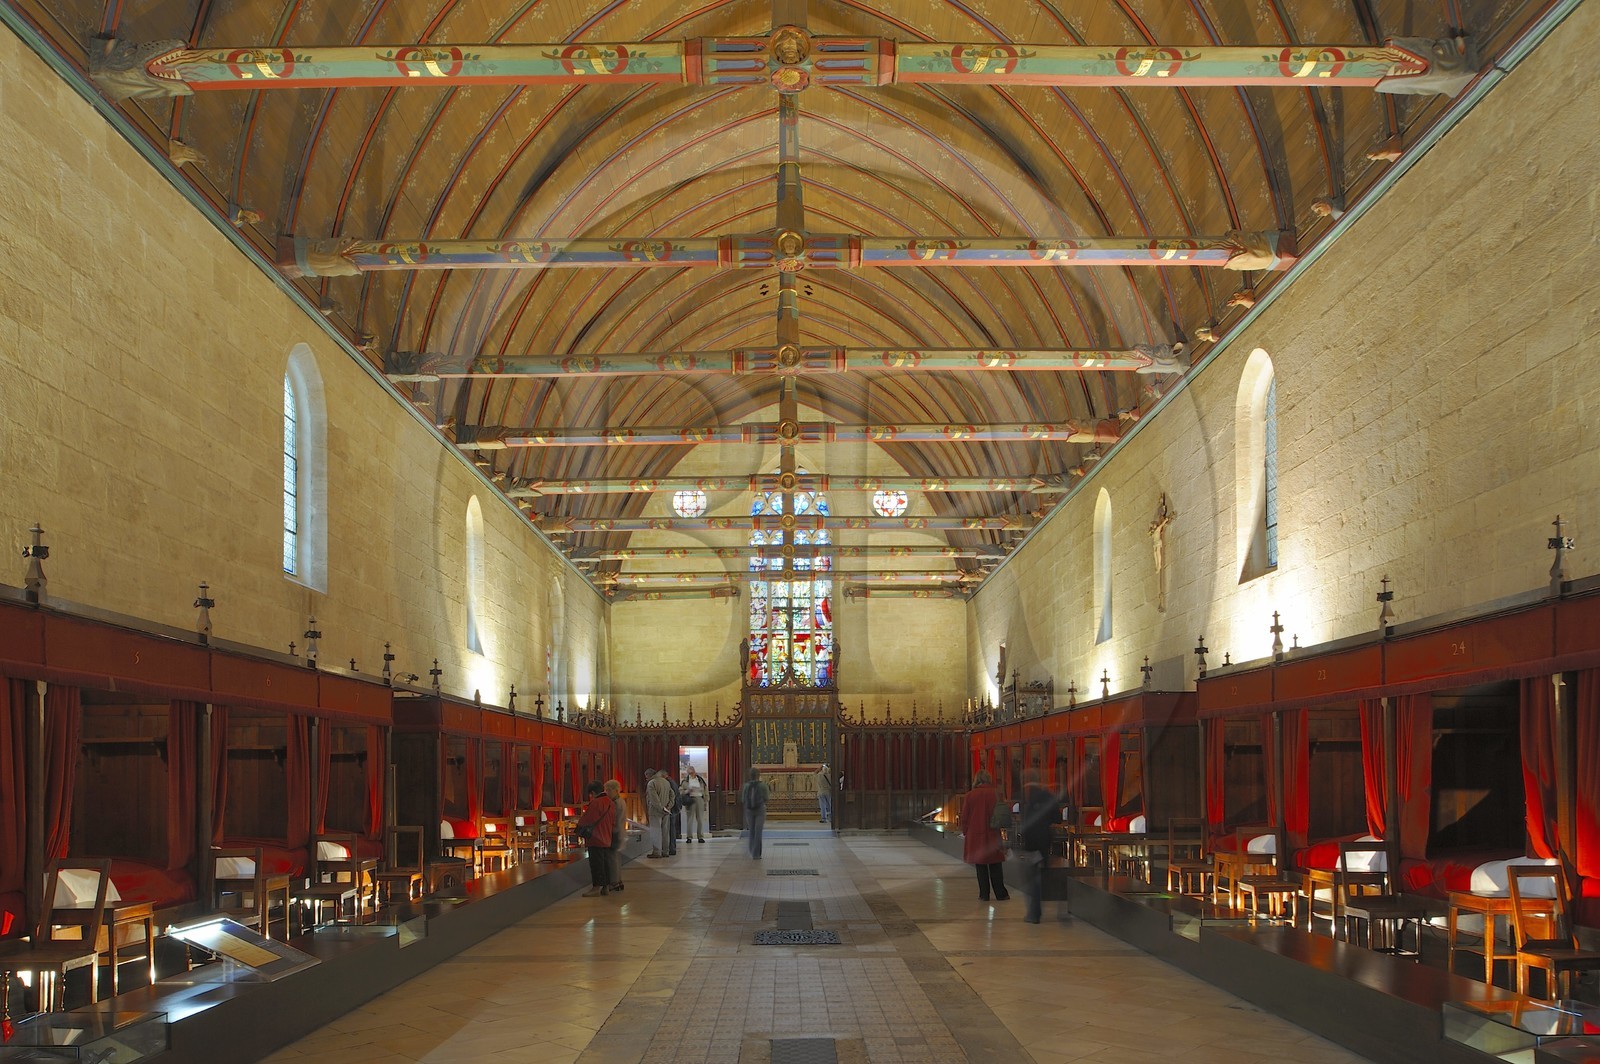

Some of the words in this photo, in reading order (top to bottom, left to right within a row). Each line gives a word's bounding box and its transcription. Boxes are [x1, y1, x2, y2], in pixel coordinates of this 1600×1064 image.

[1451, 641, 1466, 656] 24
[134, 651, 140, 665] 5
[266, 675, 272, 687] 6
[1317, 669, 1327, 680] 23
